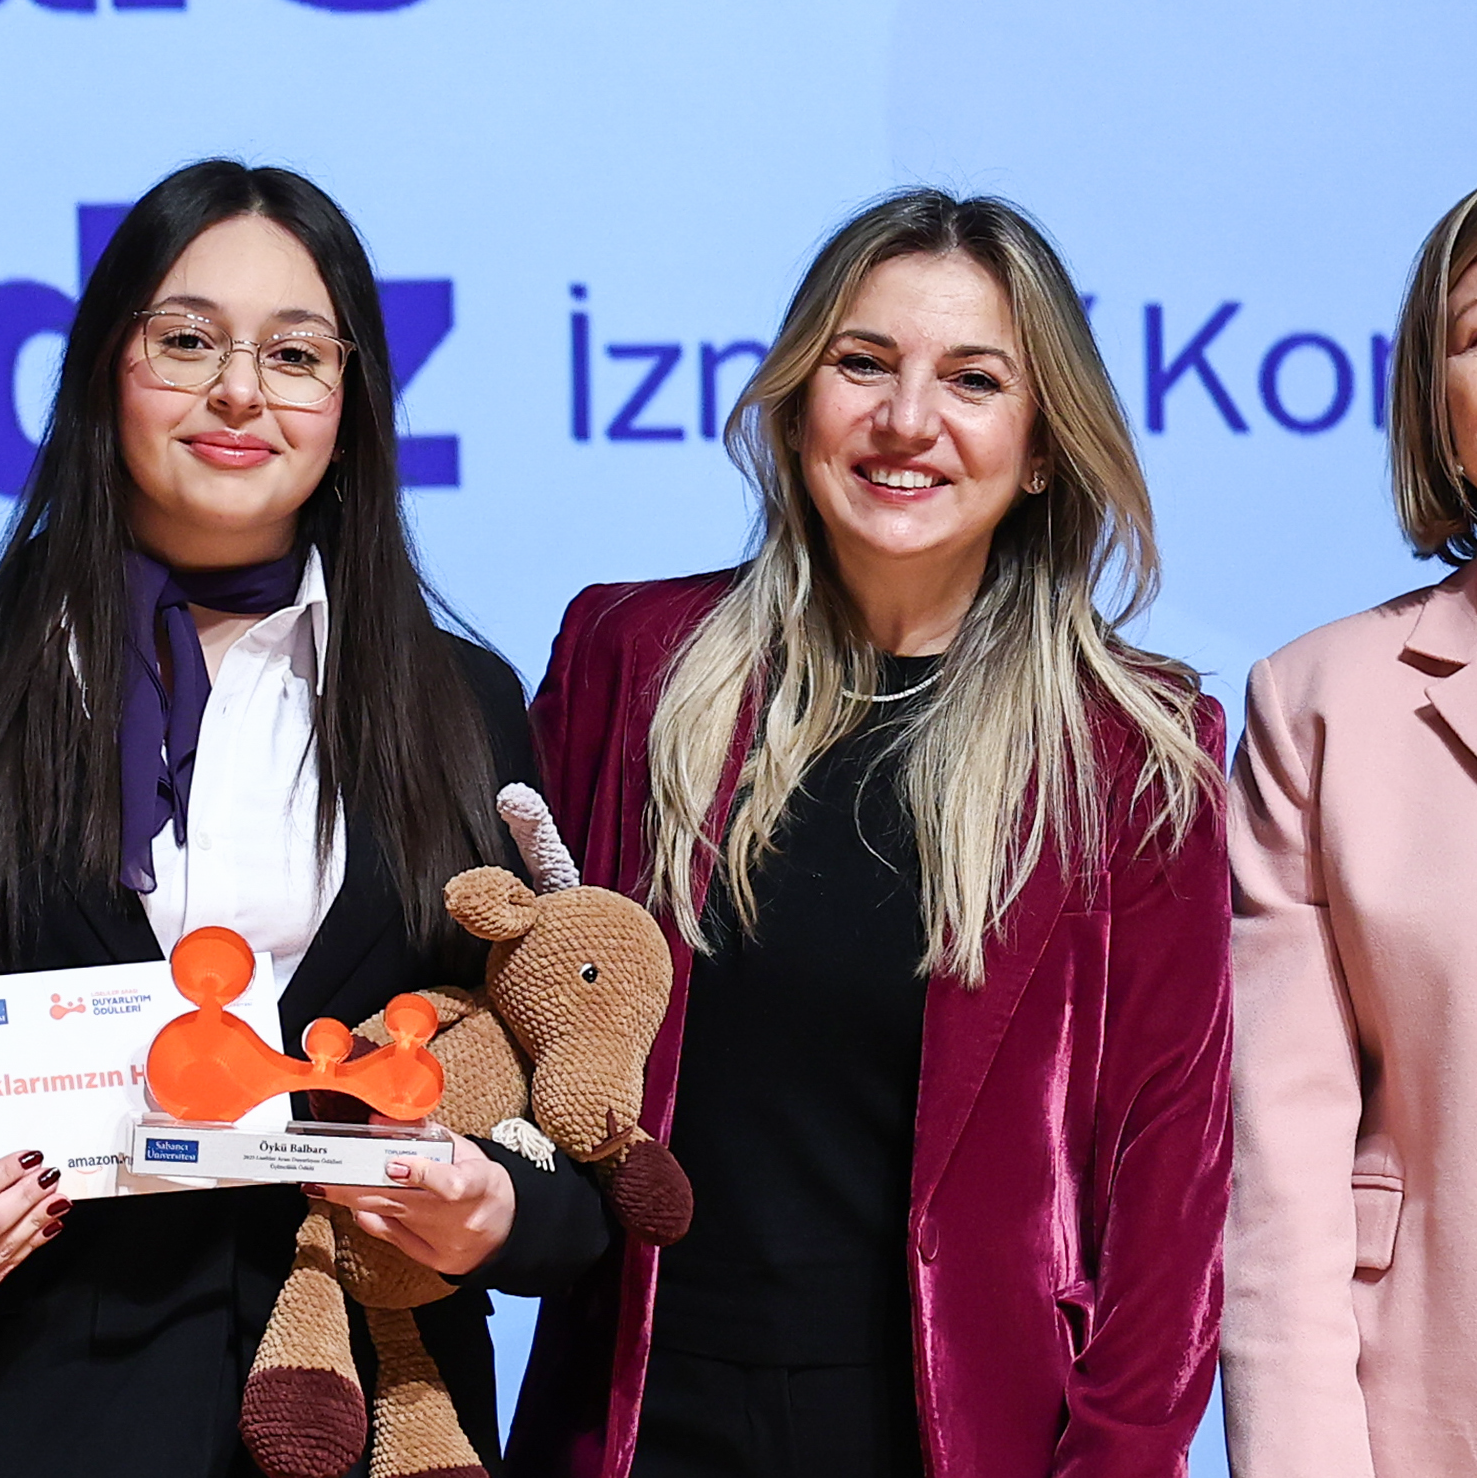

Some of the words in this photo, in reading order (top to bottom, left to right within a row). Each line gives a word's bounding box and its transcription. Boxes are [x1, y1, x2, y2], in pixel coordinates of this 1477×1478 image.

[92, 994, 152, 1007] DUYARLIYIM
[259, 1140, 287, 1154] Öykü
[290, 1142, 328, 1155] Balbars
